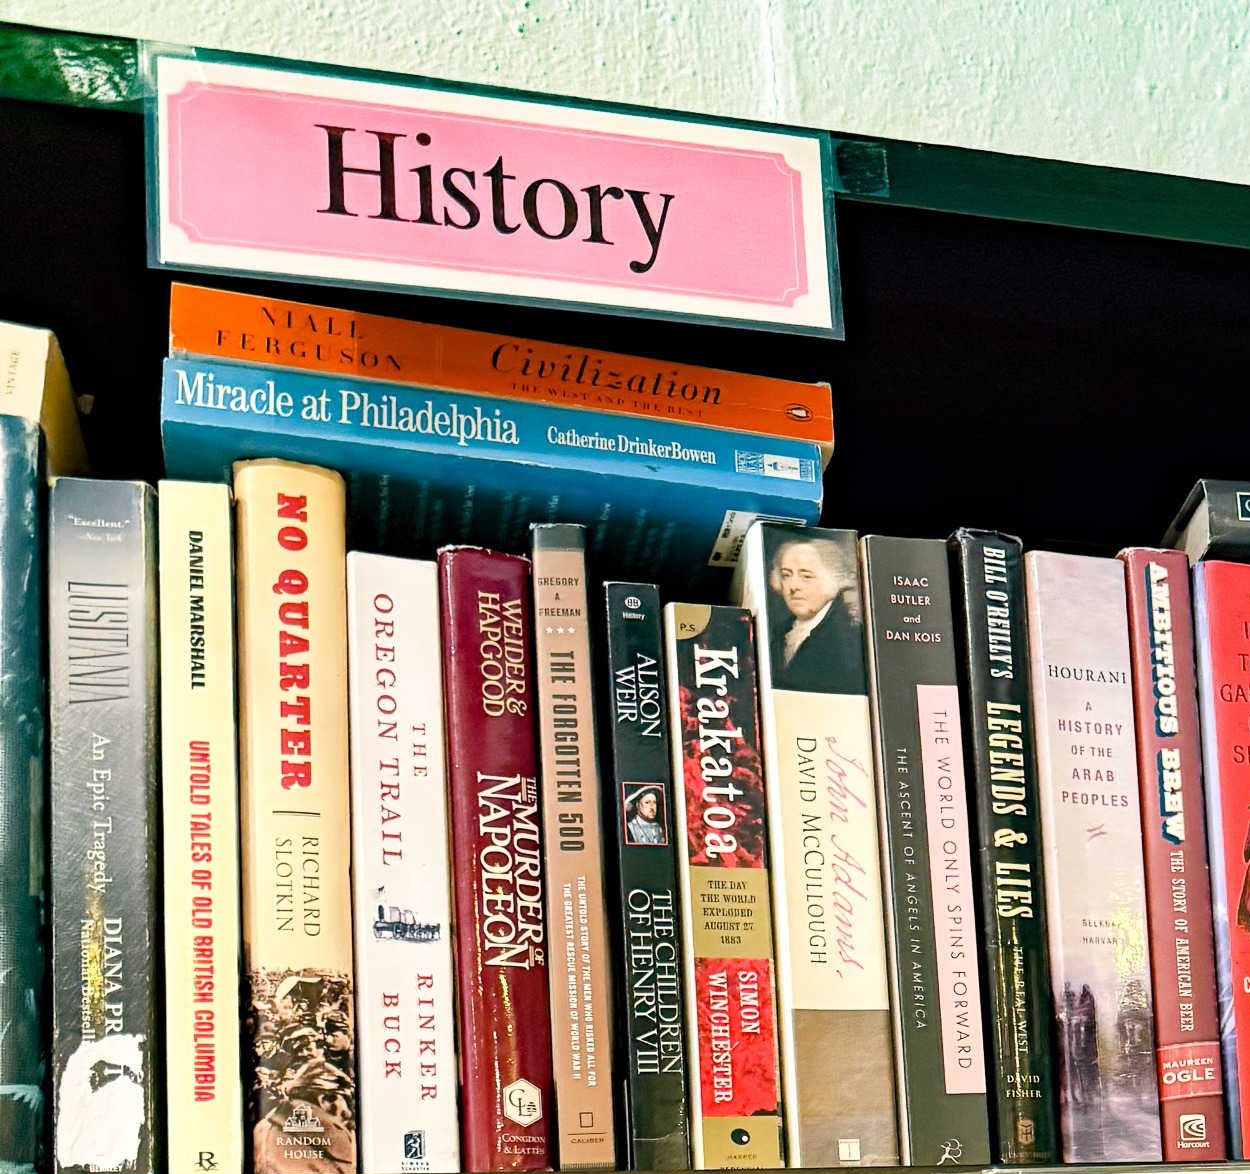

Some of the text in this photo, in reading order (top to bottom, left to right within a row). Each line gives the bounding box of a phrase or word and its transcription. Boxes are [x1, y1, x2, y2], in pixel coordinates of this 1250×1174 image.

[315, 124, 675, 273] History
[216, 330, 403, 371] FERGUSON
[260, 306, 366, 340] NIALL
[490, 341, 724, 406] Civilization
[175, 369, 520, 446] Miracle at Philadelphia
[188, 530, 206, 690] DANIEL MARSHALL
[890, 595, 931, 606] BUTLER
[893, 576, 929, 587] ISAAC
[67, 581, 130, 705] LUSITANIA
[272, 493, 312, 790] NO QUARTER
[886, 630, 941, 643] DAN KOIS
[903, 615, 921, 624] and
[477, 590, 505, 718] HAPGOOD
[501, 599, 527, 717] WEIDER &
[1048, 665, 1127, 684] HOURANI
[614, 666, 639, 724] WEIR
[636, 652, 661, 738] ALISON
[1085, 701, 1092, 712] A
[1144, 562, 1186, 845] AMBITIOUS BREW
[373, 594, 402, 866] OREGON TRAIL
[412, 723, 428, 778] THE
[549, 651, 584, 851] THE FORGOTTEN 500
[693, 643, 745, 859] Krakatoa
[1058, 720, 1122, 736] HISTORY
[1071, 745, 1112, 758] OF THE
[1062, 791, 1129, 807] PEOPLES
[1072, 768, 1114, 782] ARAB
[275, 838, 294, 933] SLOTKIN
[301, 837, 320, 937] RICHARD
[477, 771, 529, 970] NAPOLEON
[512, 802, 544, 944] MURDER
[701, 894, 756, 904] THE WORLD
[708, 881, 747, 890] THE DAY
[932, 710, 972, 1070] THE WORLD ONLY SPINS FORWARD
[189, 740, 216, 1102] UNTOLD TALES OF OLD BRITISH COLUMBIA
[703, 908, 753, 918] EXPLODED
[704, 922, 754, 931] AUGUST 27
[721, 935, 742, 944] 1883
[1170, 851, 1194, 1032] THE STORY OF AMERICAN BEER
[628, 889, 660, 1076] OF HENRY VIII
[652, 890, 684, 1074] THE CHILDREN
[737, 971, 760, 1034] SIMON
[382, 993, 402, 1079] BUCK
[416, 974, 438, 1101] RINKER
[708, 971, 732, 1104] WINCHESTER
[1162, 1057, 1213, 1069] MAUREEN
[1162, 1068, 1216, 1084] OGLE
[277, 1136, 331, 1147] RANDOM
[284, 1149, 325, 1160] HOUSE
[1177, 1140, 1209, 1148] Harcourt
